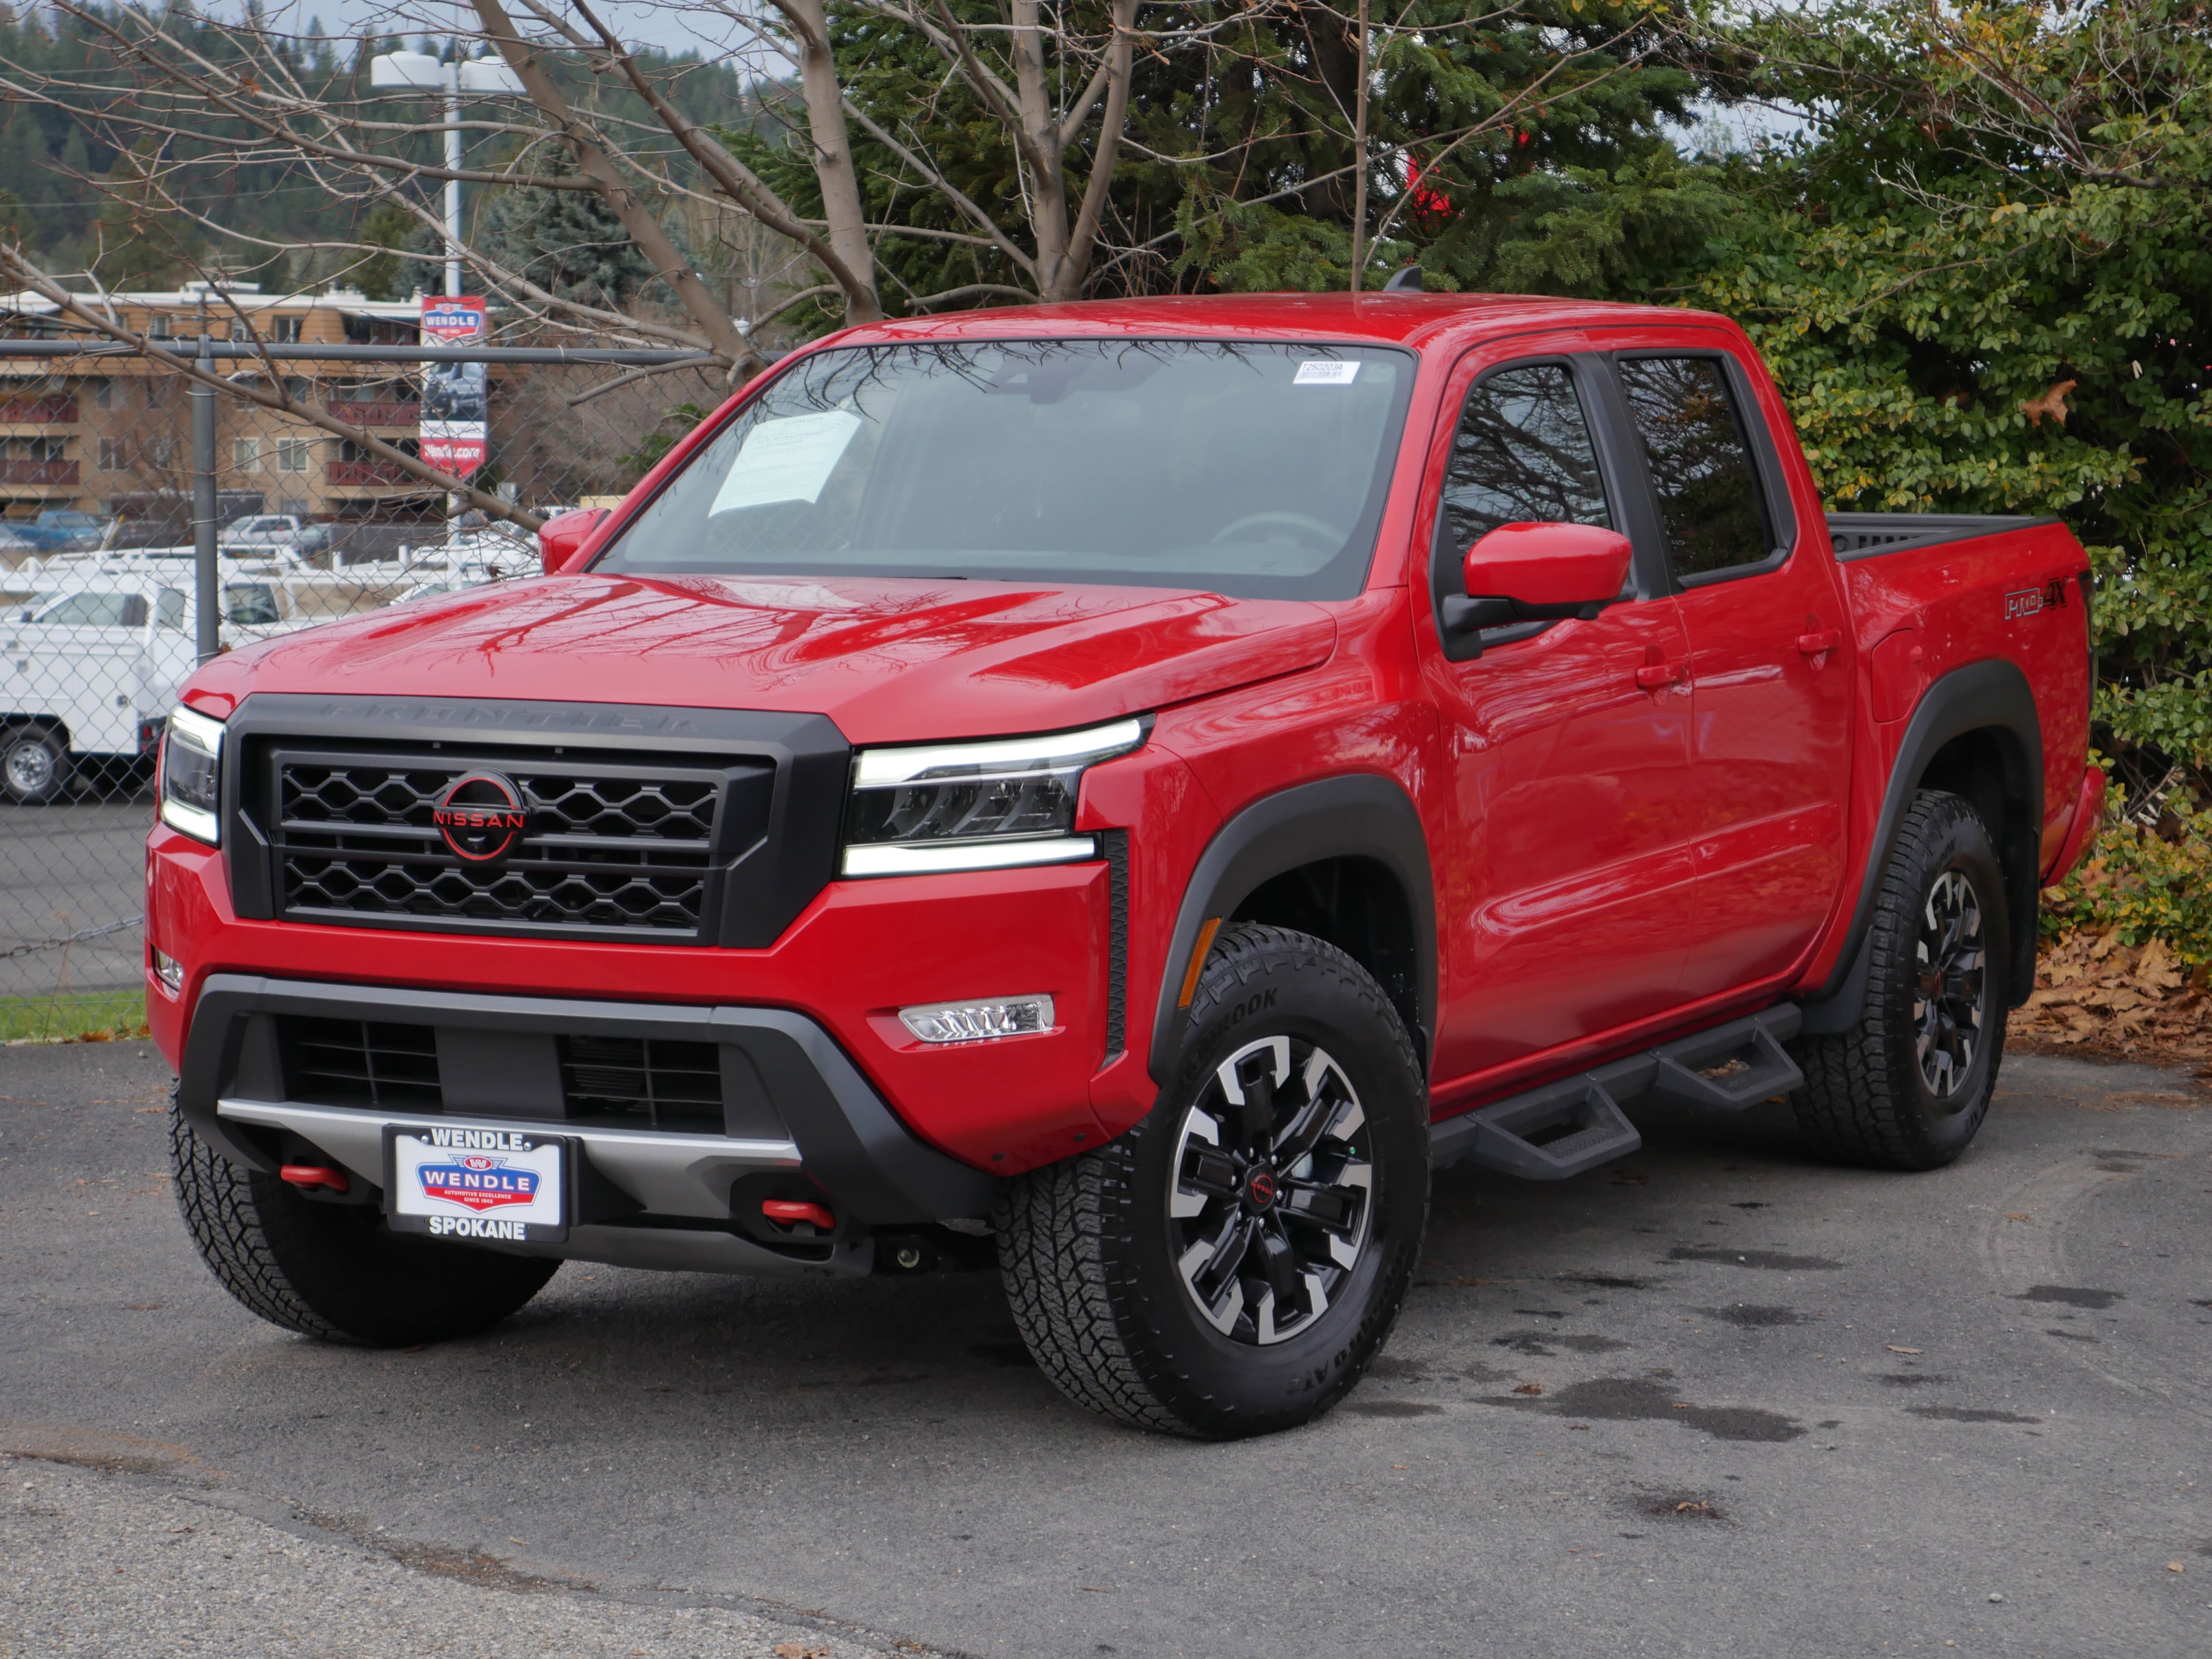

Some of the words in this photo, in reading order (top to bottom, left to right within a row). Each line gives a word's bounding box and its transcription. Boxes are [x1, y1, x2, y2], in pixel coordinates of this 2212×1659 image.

[426, 316, 476, 326] WENDLE
[319, 702, 698, 733] FRONTIER
[433, 810, 524, 828] NISSAN
[431, 1128, 524, 1151] WENDLE
[425, 1170, 530, 1191] WENDLE
[428, 1216, 526, 1241] SPOKANE
